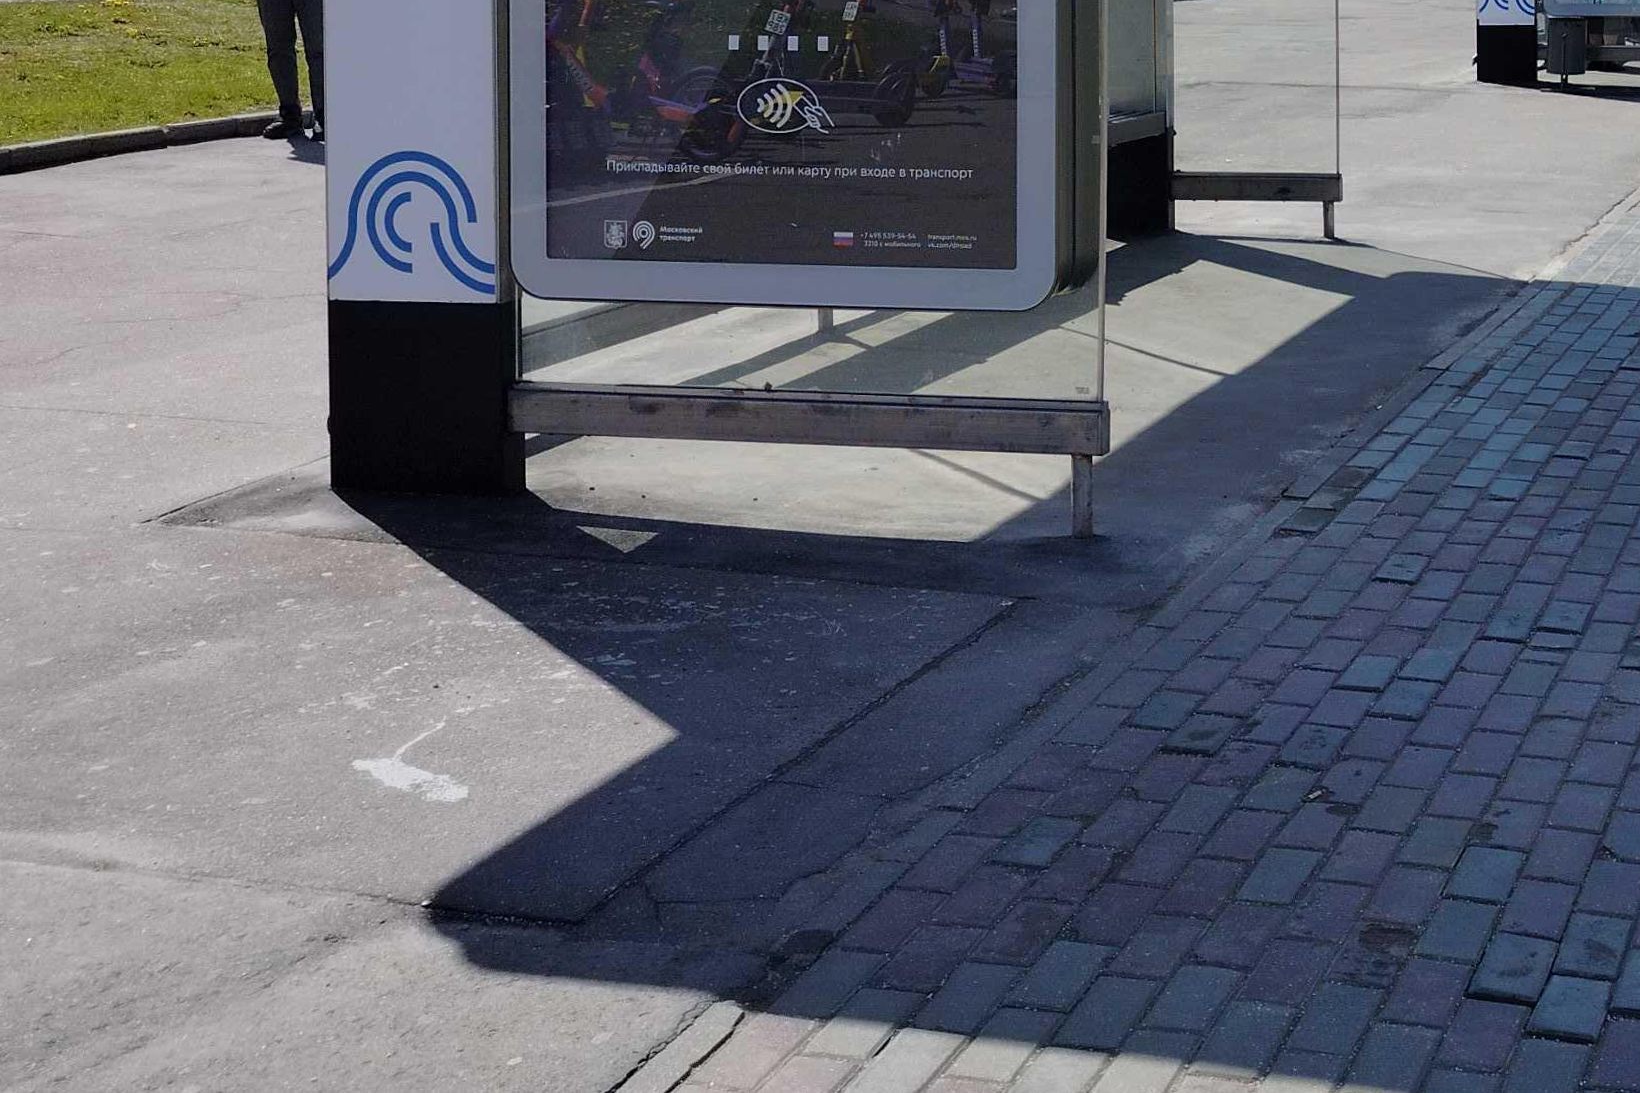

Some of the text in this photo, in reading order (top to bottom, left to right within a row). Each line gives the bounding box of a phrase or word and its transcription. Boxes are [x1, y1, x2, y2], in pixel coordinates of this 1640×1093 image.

[606, 159, 974, 181] Прикладывайте свой билет или карту при входе в транспорт
